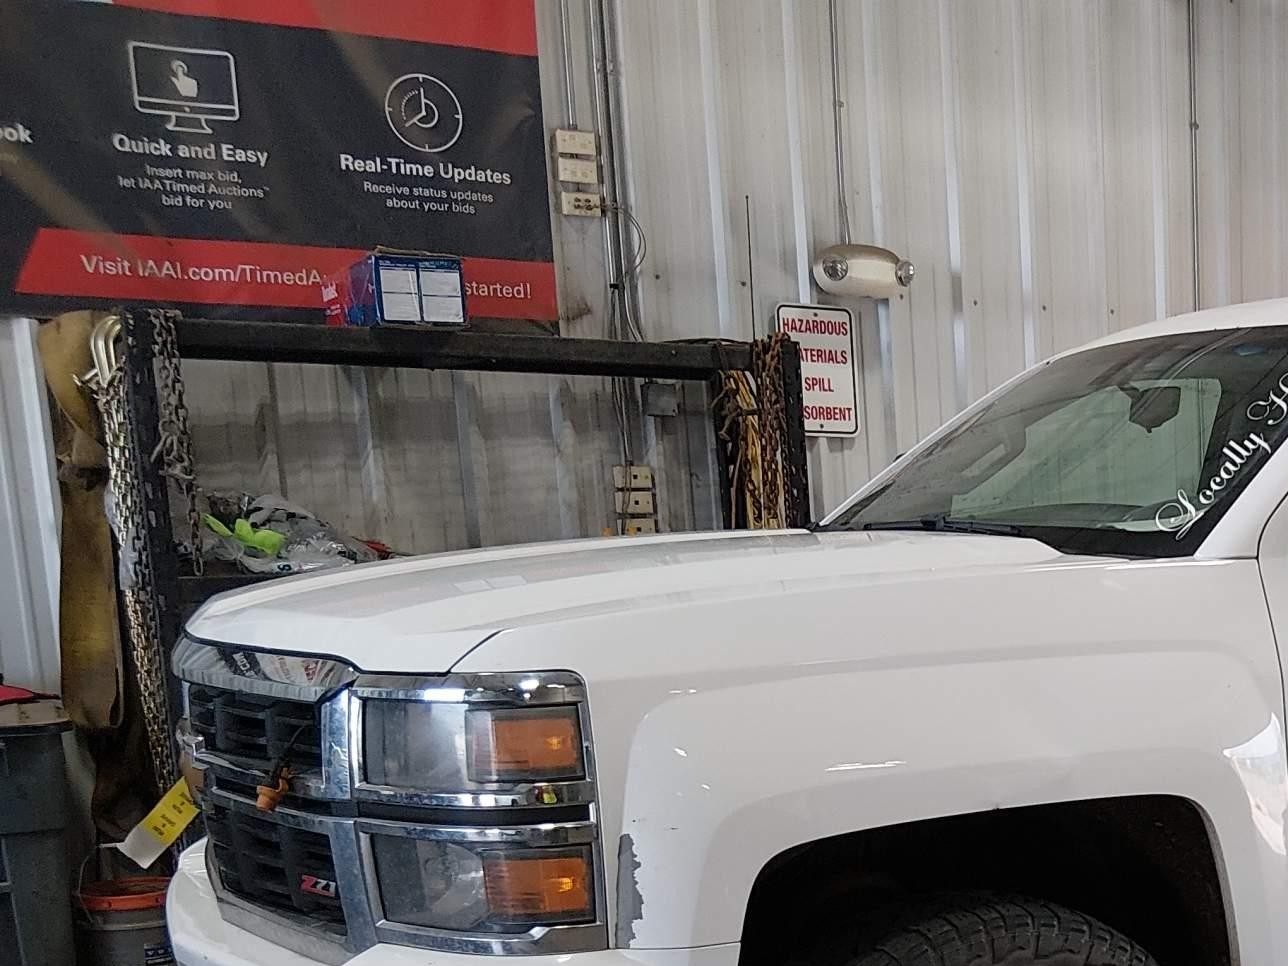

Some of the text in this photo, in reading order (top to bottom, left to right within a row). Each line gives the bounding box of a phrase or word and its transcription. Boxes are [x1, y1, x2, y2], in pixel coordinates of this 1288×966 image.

[0, 123, 33, 143] ok
[112, 133, 269, 168] Quick and Easy
[145, 164, 242, 184] Insert max bid,
[339, 153, 512, 185] Real-Time Updates
[118, 175, 136, 188] let
[138, 177, 163, 192] IAA
[163, 179, 206, 194] Timed
[363, 181, 494, 203] Receive status updates
[161, 194, 233, 211] bid for you
[386, 197, 476, 215] about your bids
[80, 254, 132, 276] Visit
[136, 258, 327, 286] IAAI.com/TimedA
[464, 281, 531, 299] started!
[782, 317, 848, 336] HAZARDOUS
[804, 376, 834, 393] SPILL
[803, 405, 853, 422] SORBENT
[301, 874, 336, 897] Z71
